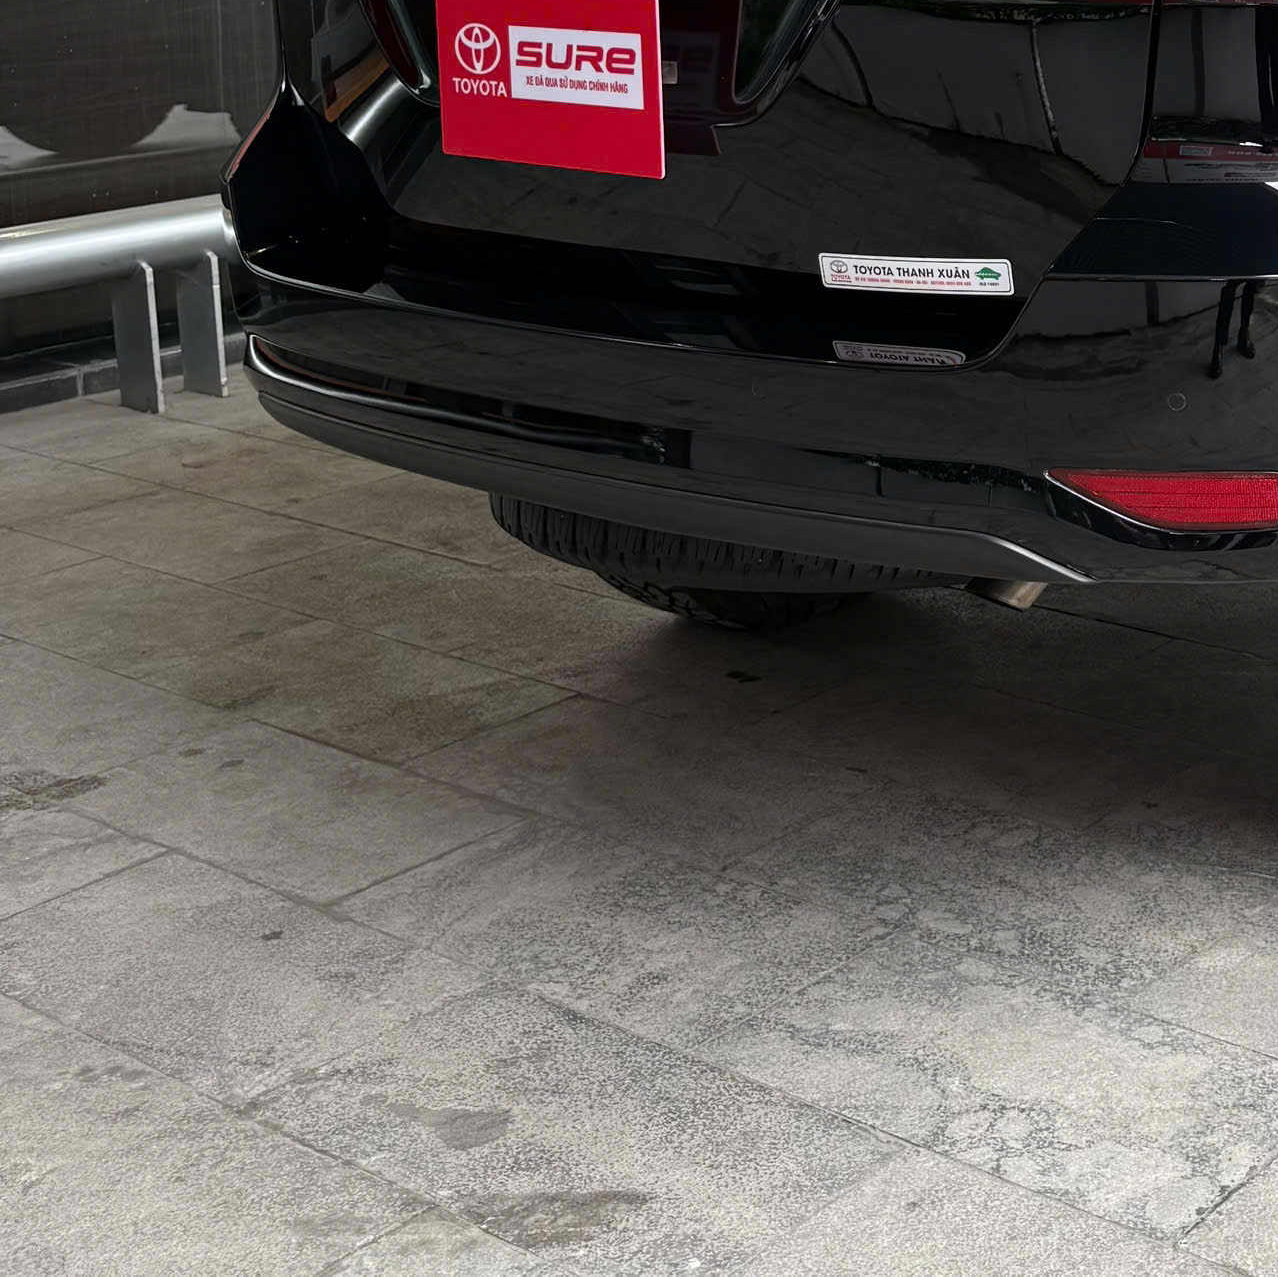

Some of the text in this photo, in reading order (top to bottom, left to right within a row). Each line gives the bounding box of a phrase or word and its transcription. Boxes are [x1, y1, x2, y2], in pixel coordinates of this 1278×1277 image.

[452, 77, 508, 98] TOYOTA
[526, 75, 534, 86] XE
[535, 75, 544, 87] ĐÃ
[545, 77, 558, 88] QUA
[559, 75, 568, 89] SỬ
[569, 79, 588, 91] DỤNG
[588, 78, 609, 92] CHÍNH
[853, 264, 894, 276] TOYOTA
[896, 267, 934, 278] THANH
[938, 266, 970, 279] XUÂN
